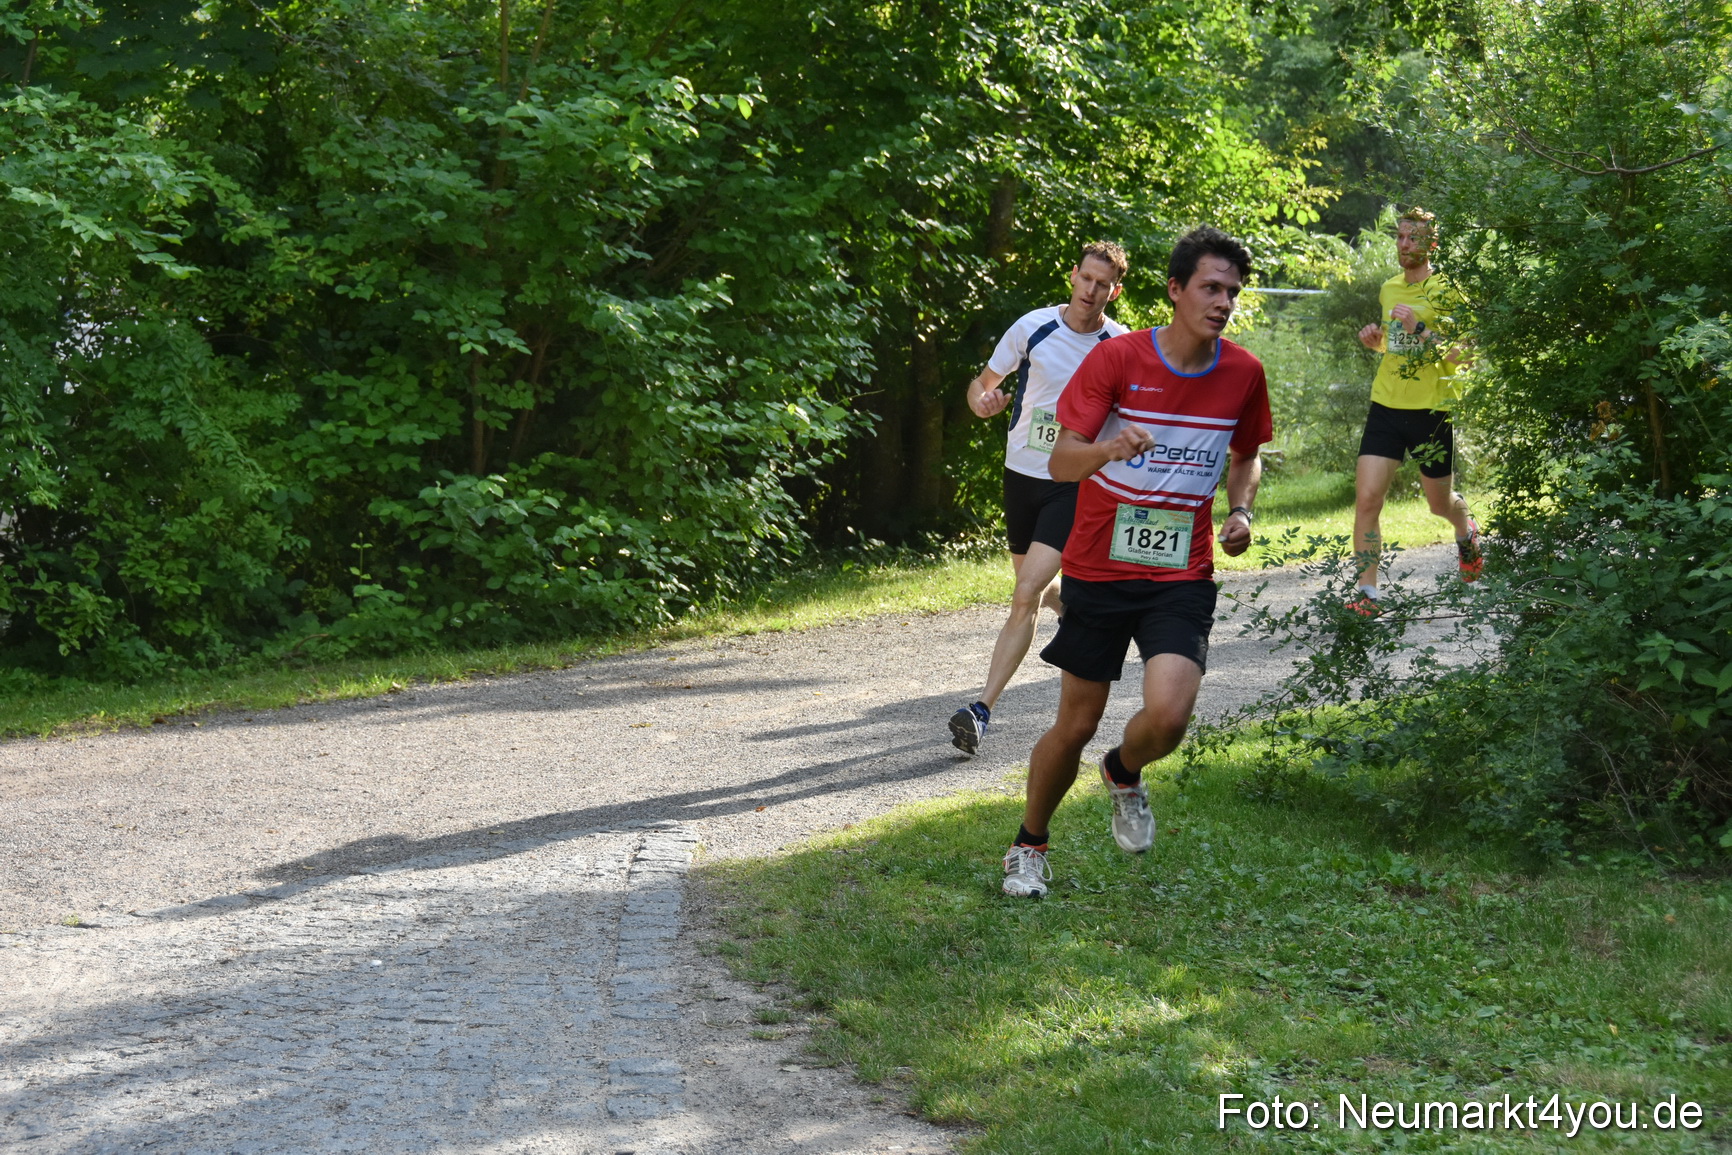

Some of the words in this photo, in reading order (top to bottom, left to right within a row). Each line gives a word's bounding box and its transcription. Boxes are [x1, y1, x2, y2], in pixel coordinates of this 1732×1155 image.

[1150, 444, 1219, 468] Petry
[1124, 526, 1179, 552] 1821
[1152, 550, 1173, 558] Florian
